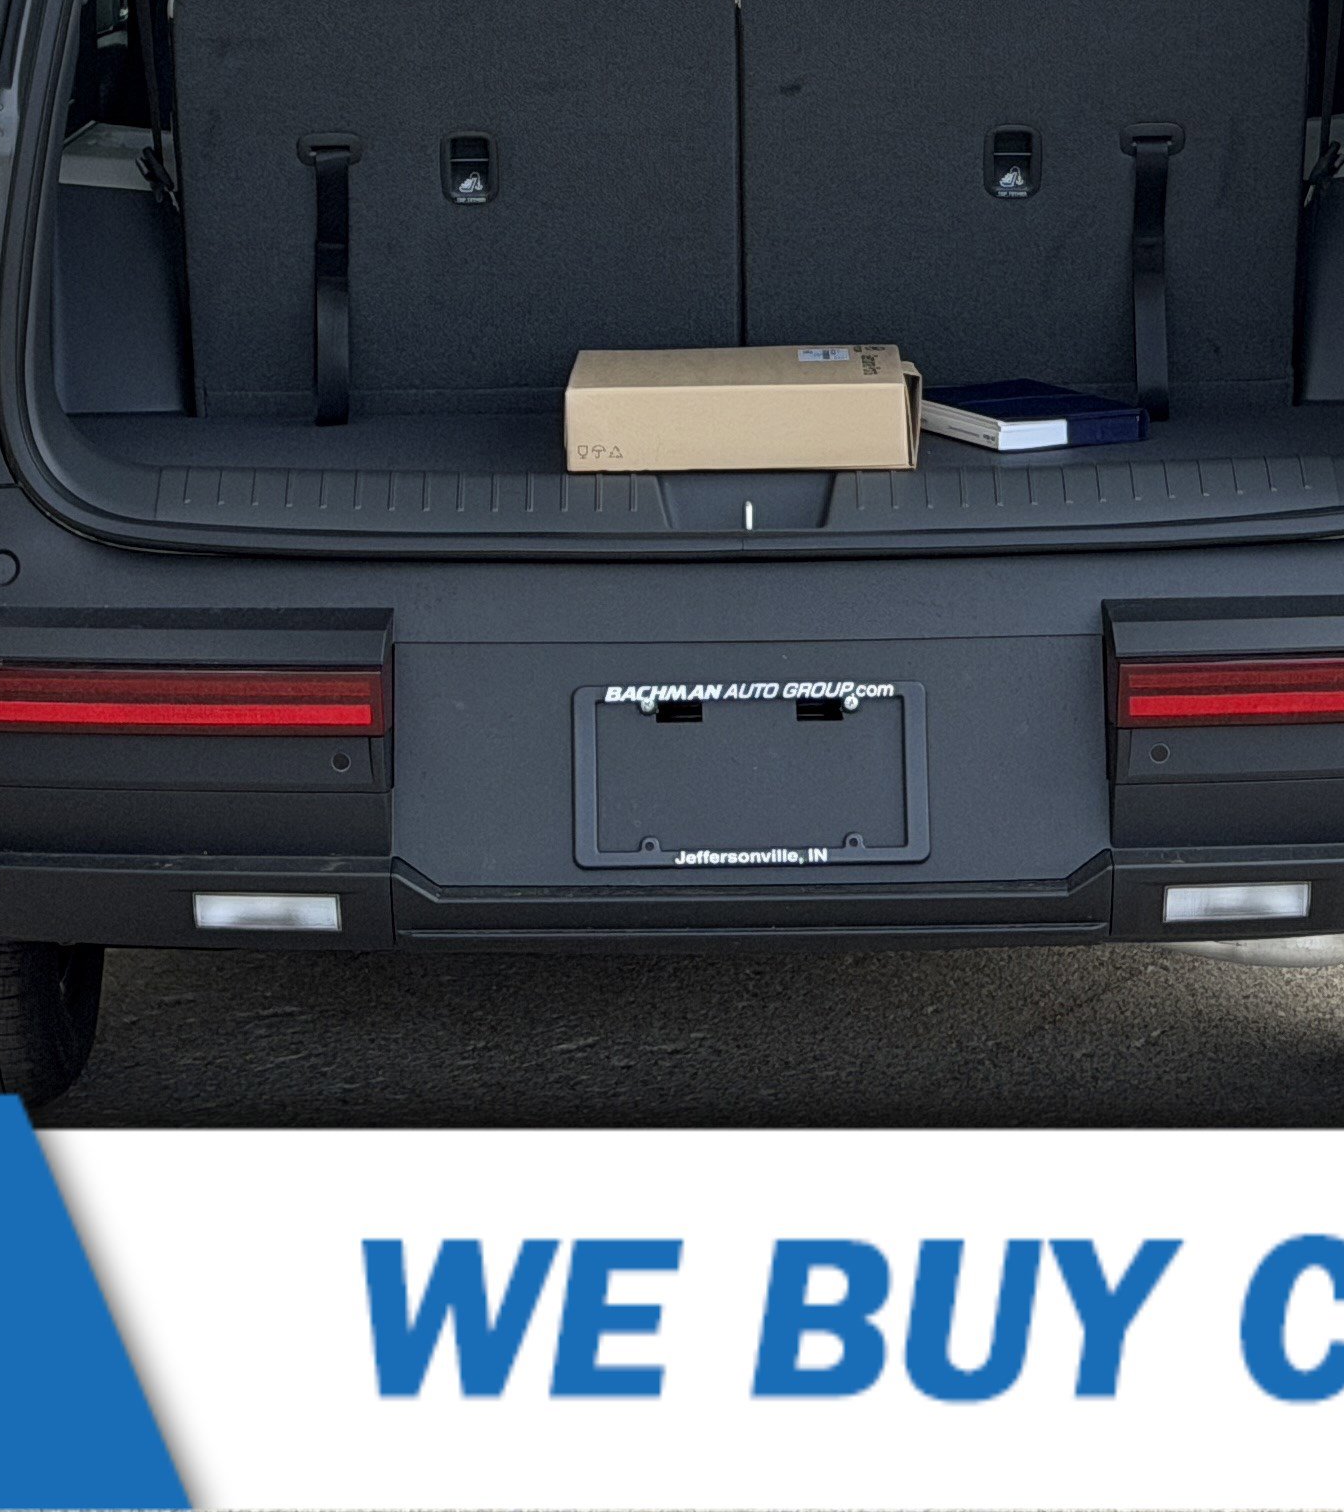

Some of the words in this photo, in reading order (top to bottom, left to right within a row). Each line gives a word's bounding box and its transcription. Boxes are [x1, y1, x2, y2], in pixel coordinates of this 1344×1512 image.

[605, 684, 722, 702] BACHMAN
[722, 682, 780, 700] AUTO
[674, 848, 805, 865] Jeffersonville,
[807, 847, 828, 863] IN
